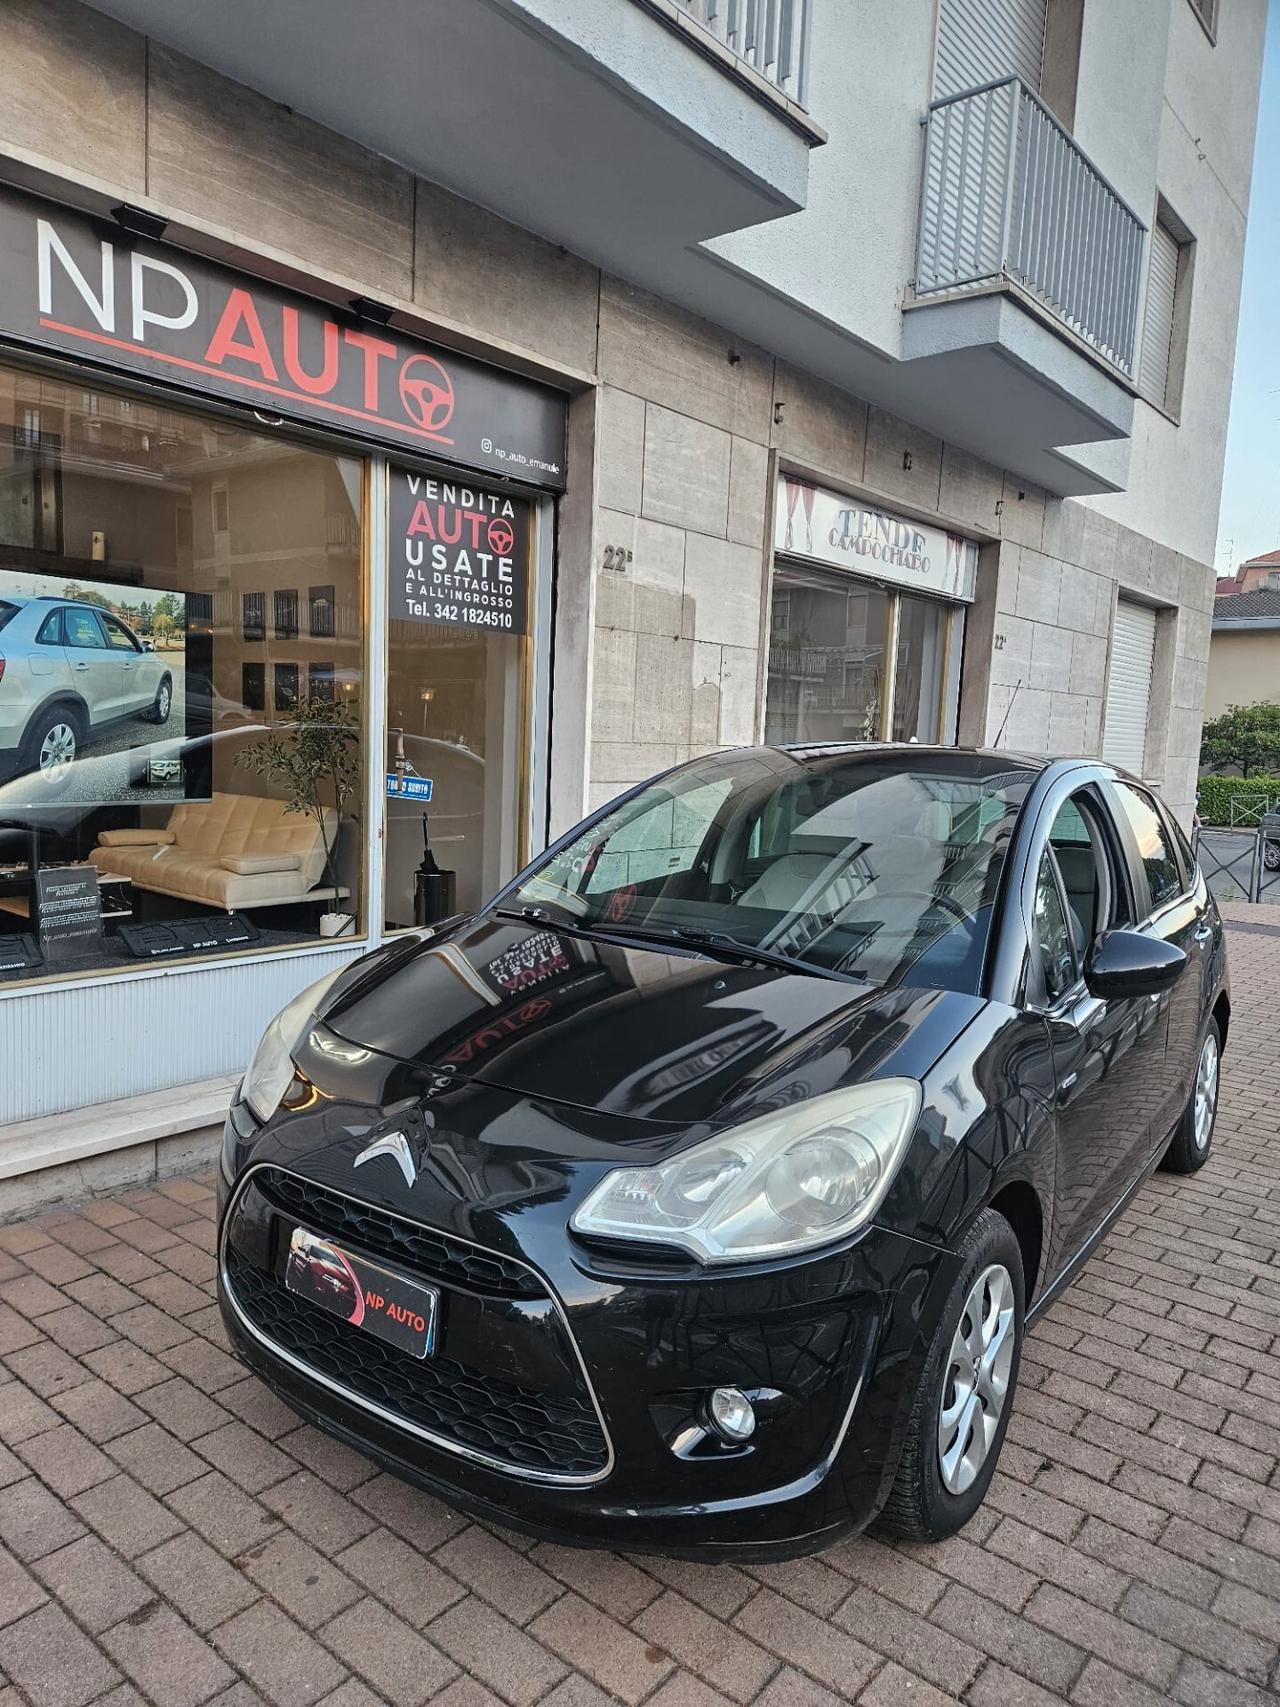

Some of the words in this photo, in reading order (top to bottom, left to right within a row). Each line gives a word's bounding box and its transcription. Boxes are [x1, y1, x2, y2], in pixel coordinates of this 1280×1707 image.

[406, 474, 515, 518] VENDITA
[406, 500, 514, 555] AUTO
[838, 509, 926, 553] TENDE
[405, 538, 513, 583] USATE
[405, 583, 413, 593] E
[419, 587, 513, 609] ALL'INGROSSO
[406, 568, 426, 581] AL
[433, 572, 513, 596] DETTAGLIO
[405, 598, 430, 617] Tel.
[434, 603, 458, 621] 342
[461, 607, 512, 628] 1824510
[366, 1291, 385, 1310] NP
[386, 1303, 425, 1332] AUTO
